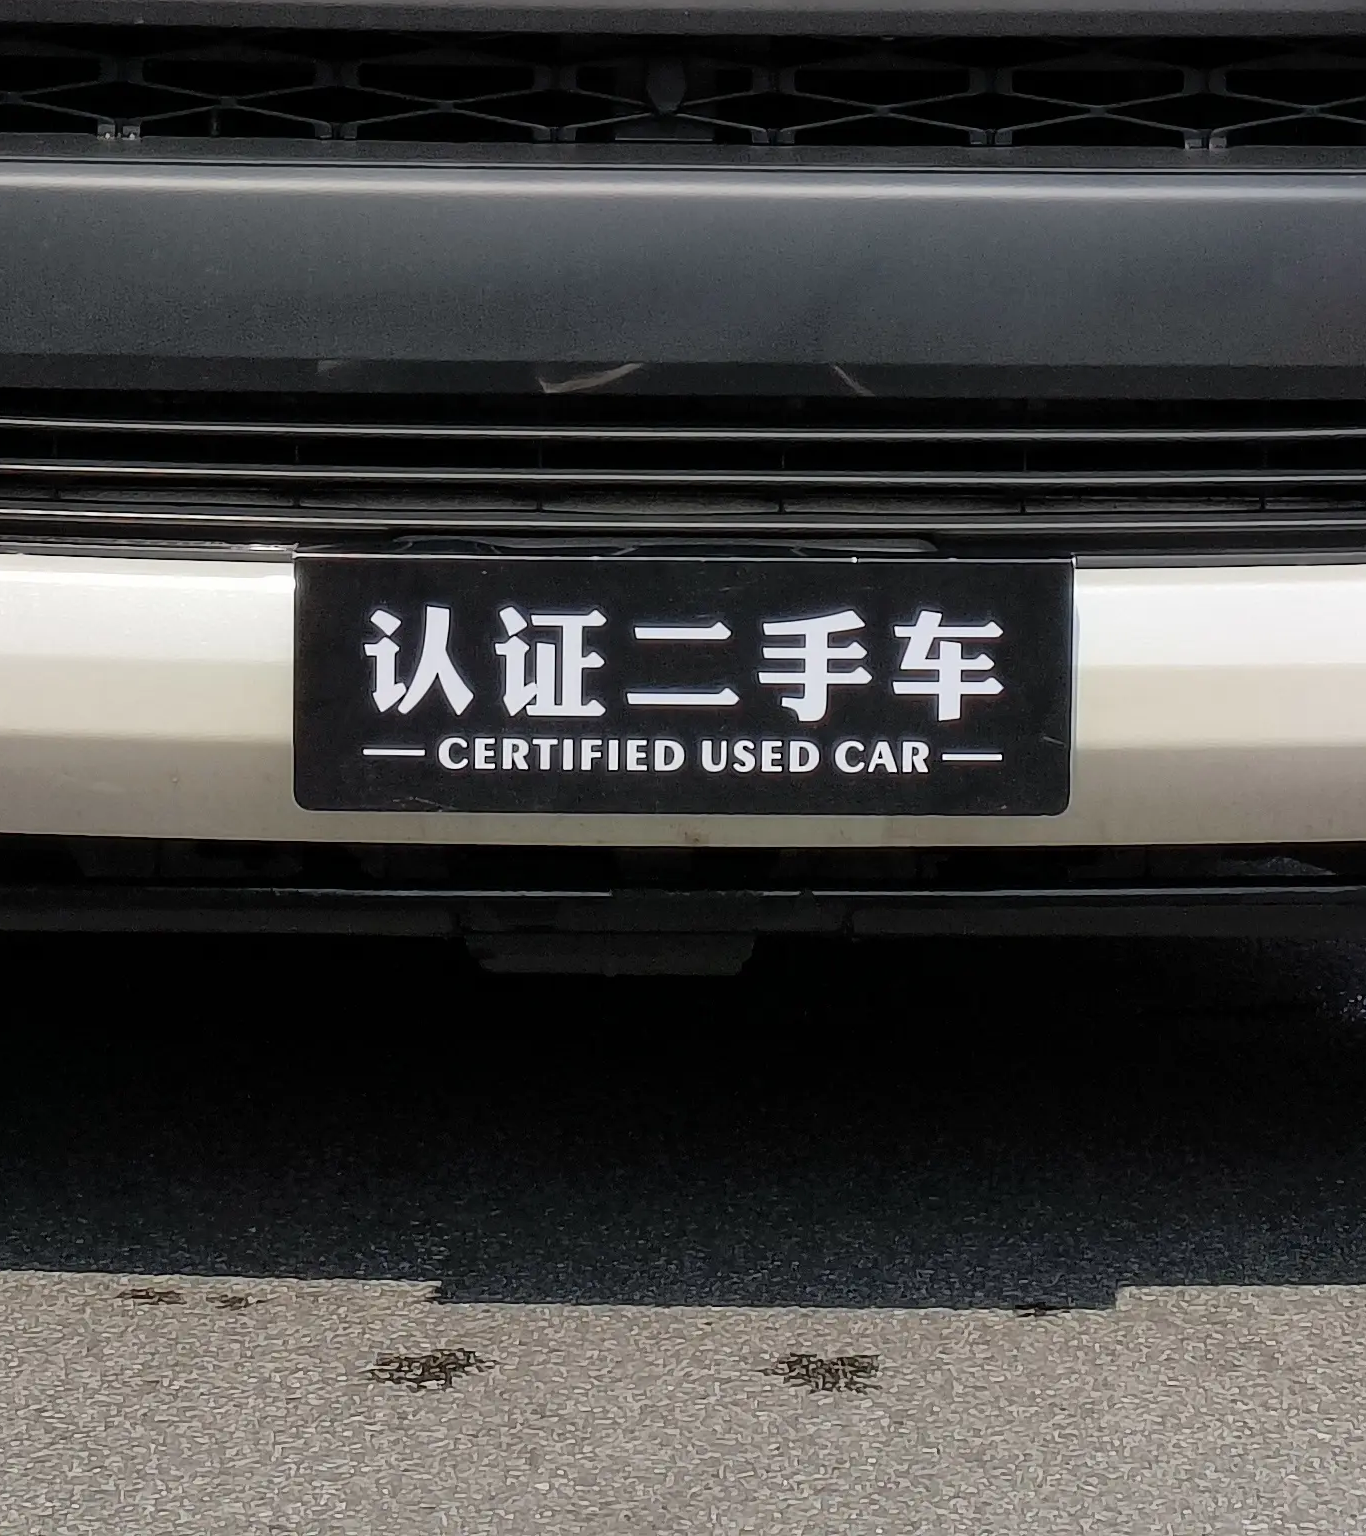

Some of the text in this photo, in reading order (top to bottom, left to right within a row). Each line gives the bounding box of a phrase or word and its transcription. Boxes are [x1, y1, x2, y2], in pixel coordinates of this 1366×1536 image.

[363, 605, 1004, 722] 认证二手车
[438, 737, 930, 774] CERTIFIED USED CAR
